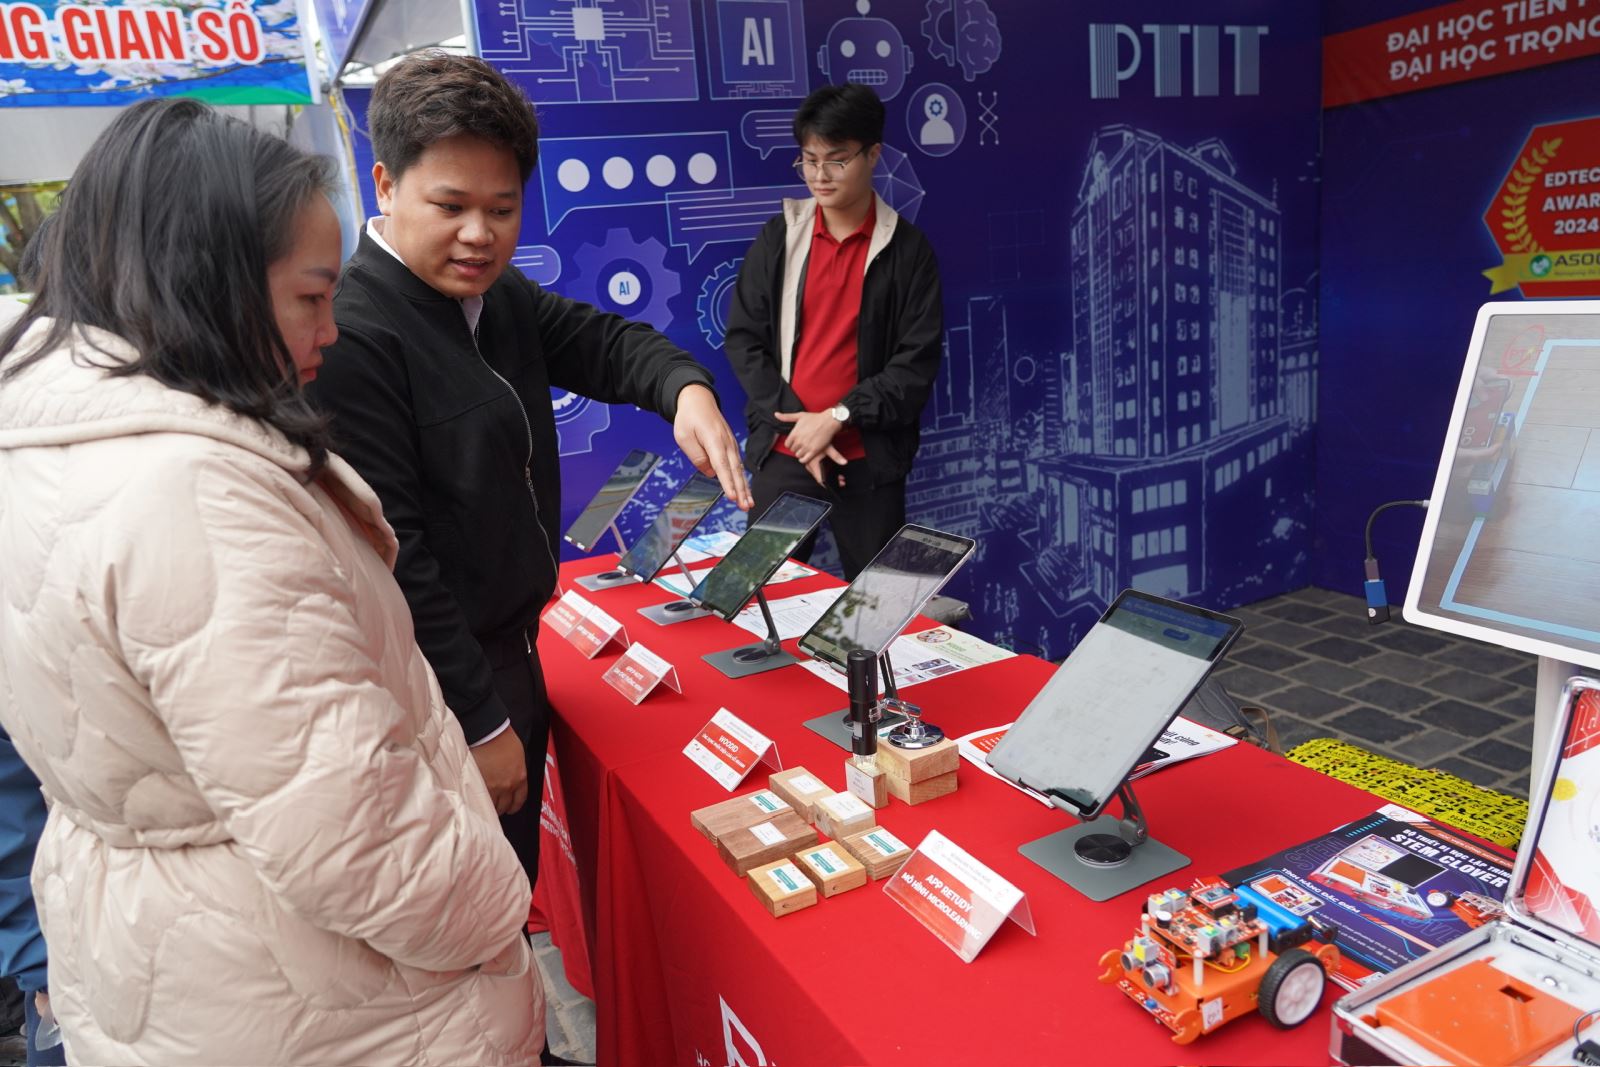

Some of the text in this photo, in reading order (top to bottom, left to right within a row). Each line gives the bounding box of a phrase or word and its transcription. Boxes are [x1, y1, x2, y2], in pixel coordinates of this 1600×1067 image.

[62, 8, 187, 61] GIAN
[742, 17, 775, 66] AI
[1386, 25, 1430, 53] ĐẠI
[1437, 9, 1495, 41] HỌC
[1089, 23, 1269, 99] PTIT
[1389, 54, 1432, 83] ĐẠI
[1440, 40, 1496, 72] HỌC
[1553, 217, 1599, 235] 2024
[619, 280, 630, 296] AI
[1391, 834, 1509, 888] STEM CLOVER
[925, 874, 974, 913] APP RETUDY
[927, 892, 983, 940] MICROLEARNING
